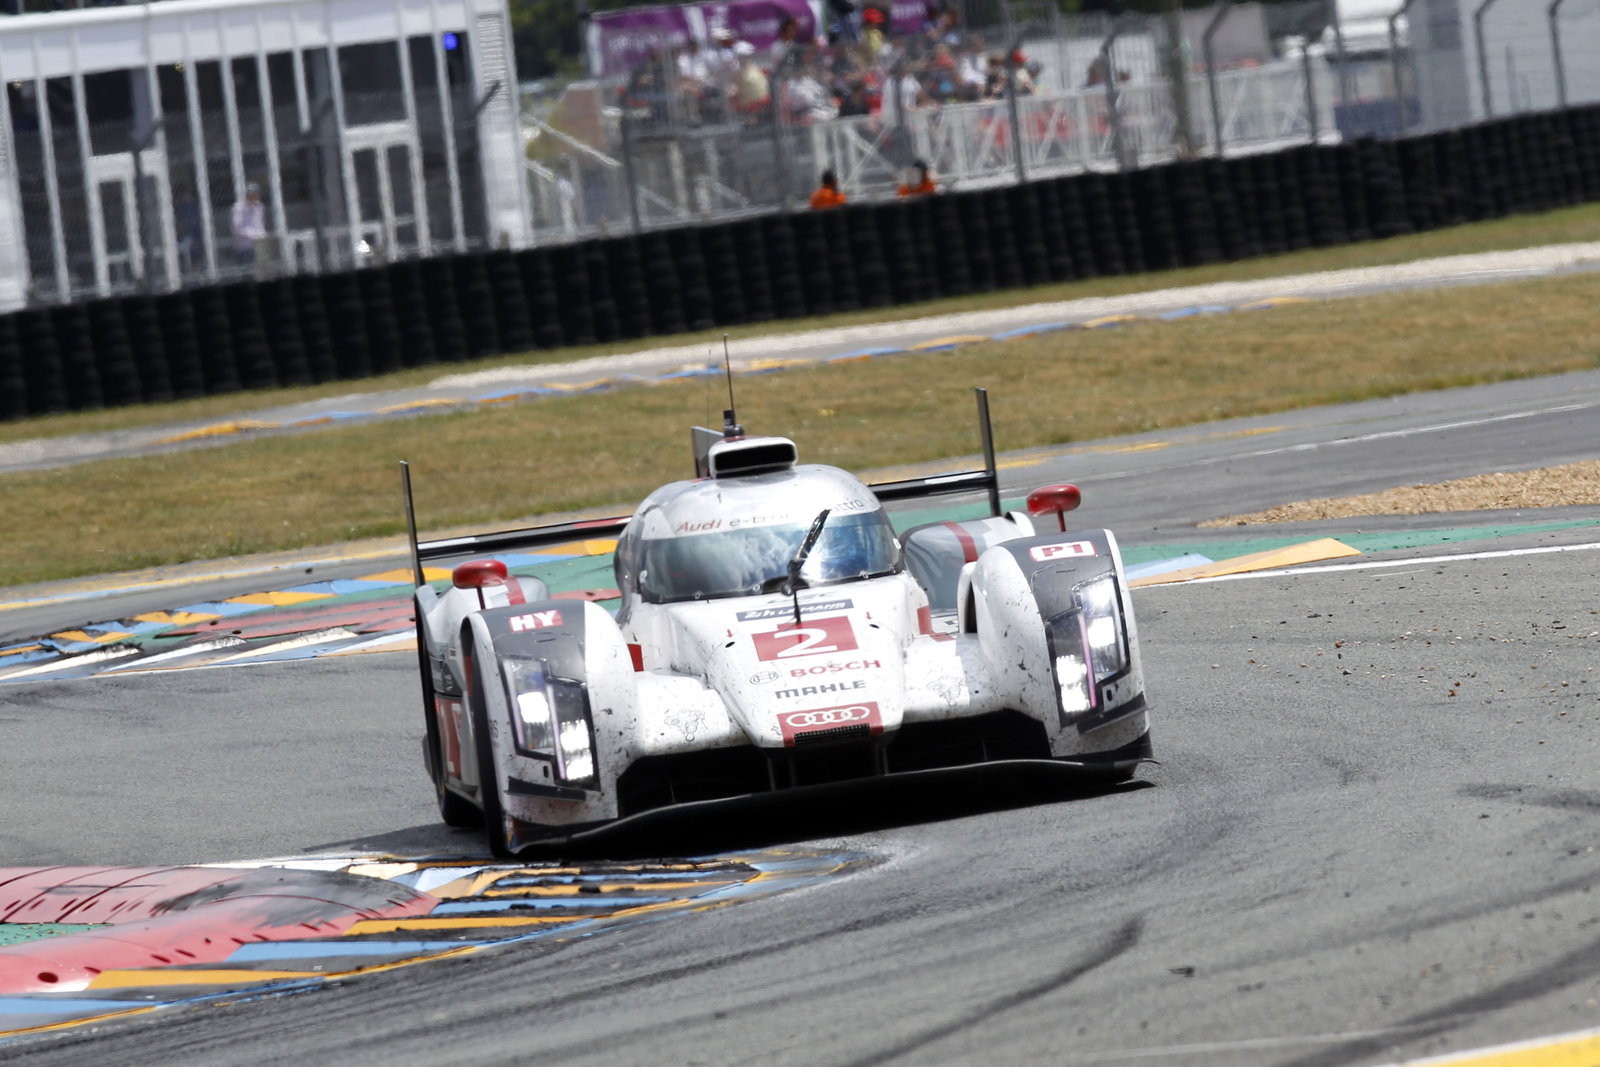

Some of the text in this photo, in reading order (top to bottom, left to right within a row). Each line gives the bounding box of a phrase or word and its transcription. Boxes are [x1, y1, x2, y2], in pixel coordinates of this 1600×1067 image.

[676, 519, 722, 533] Audi
[1041, 544, 1083, 557] P1
[509, 609, 557, 632] HY
[773, 628, 838, 658] 2
[790, 660, 881, 678] BOSCH
[775, 680, 866, 699] MAHLE
